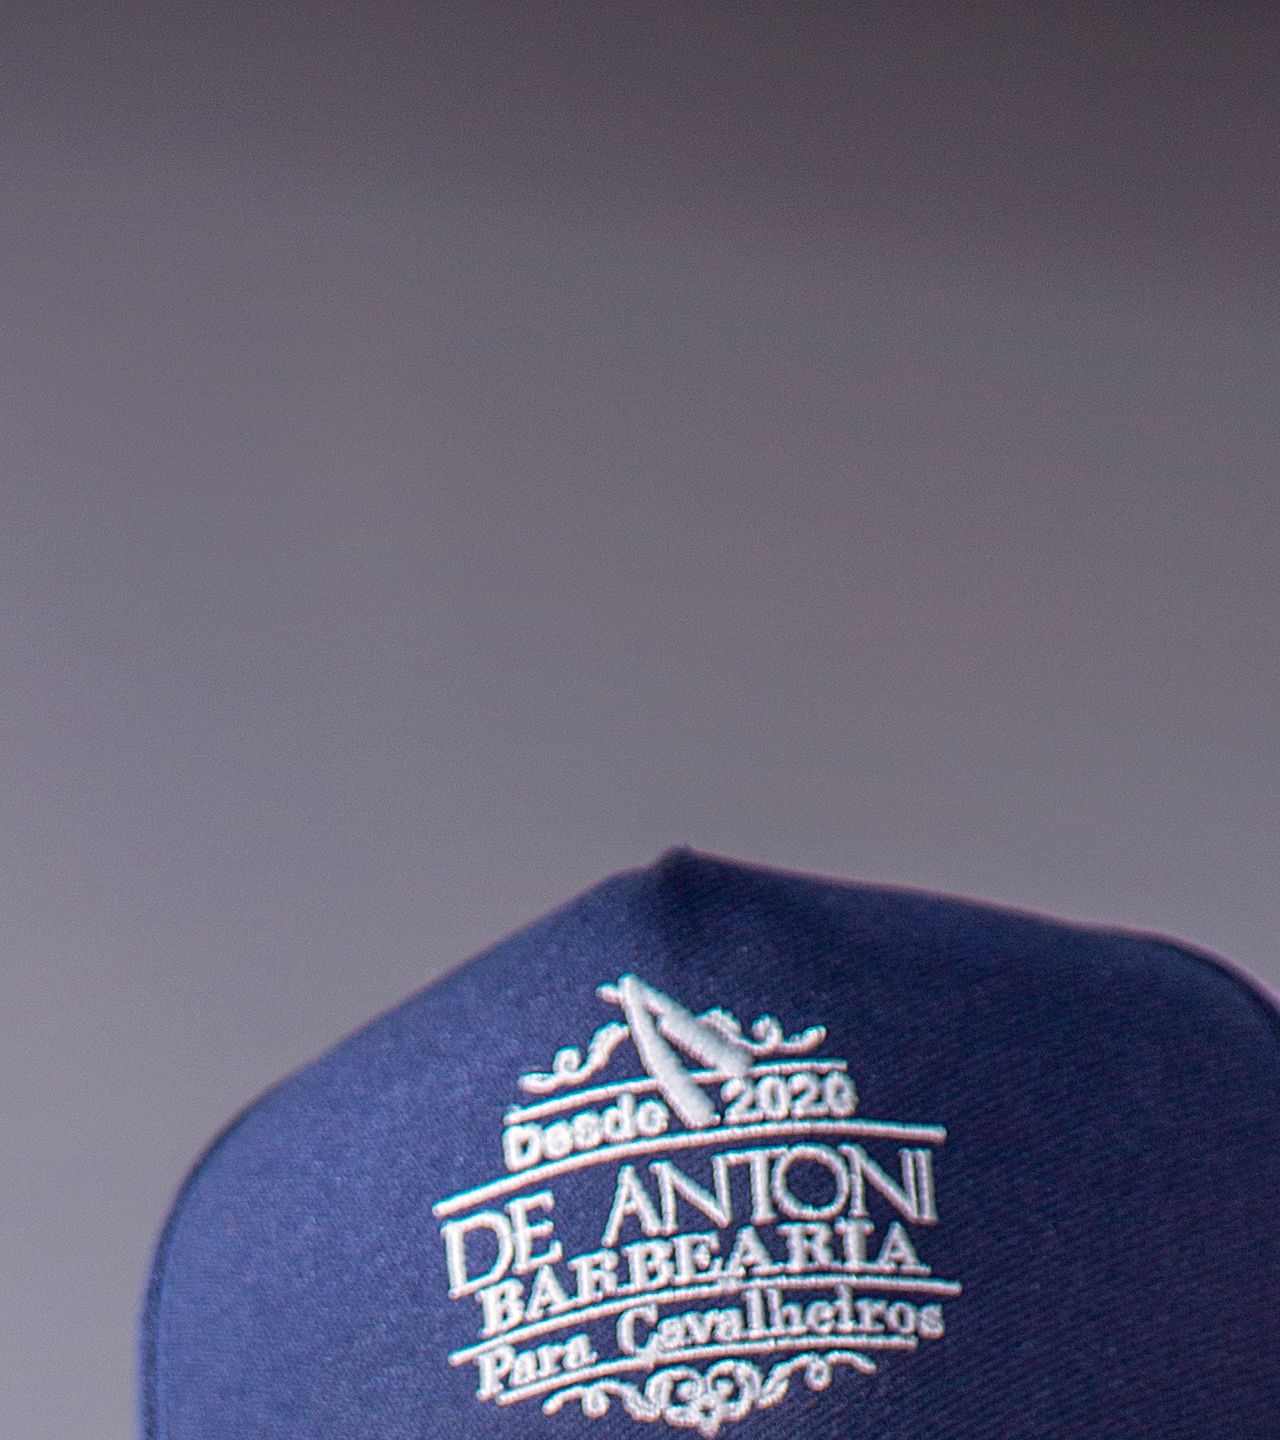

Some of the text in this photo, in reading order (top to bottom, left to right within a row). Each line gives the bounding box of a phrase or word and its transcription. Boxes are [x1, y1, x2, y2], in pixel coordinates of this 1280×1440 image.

[719, 1071, 858, 1122] 2020
[440, 1143, 937, 1298] DE ANTONI
[474, 1222, 931, 1337] BARBEARIA
[477, 1285, 945, 1401] Para Cavalheiros
